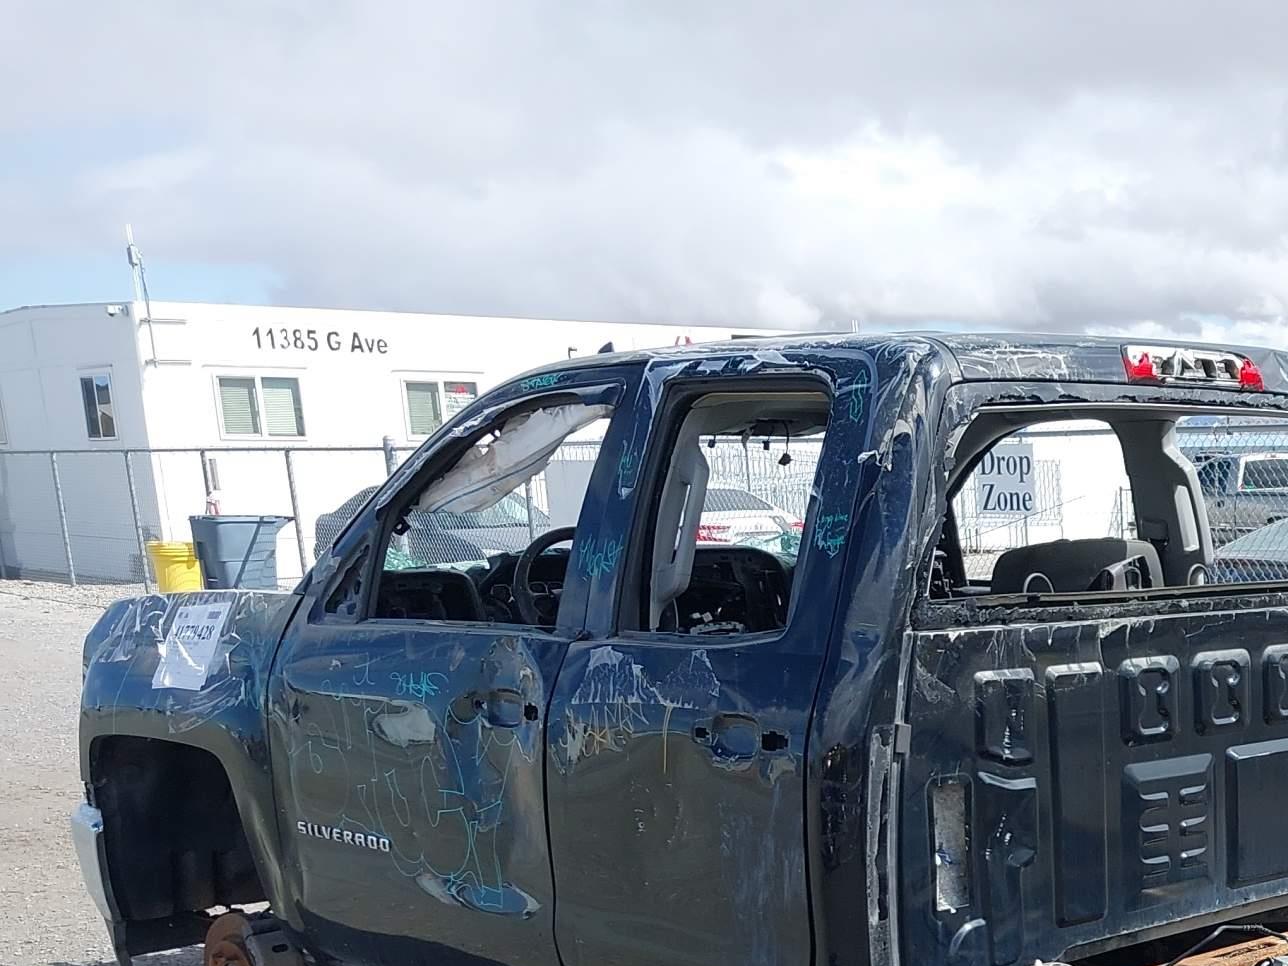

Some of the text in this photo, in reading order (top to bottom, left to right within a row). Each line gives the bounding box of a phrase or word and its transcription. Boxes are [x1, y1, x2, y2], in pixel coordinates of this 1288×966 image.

[252, 326, 388, 354] 11385 G Ave
[980, 450, 1031, 483] Drop
[982, 483, 1033, 511] Zone
[297, 821, 390, 853] SILVERADO
